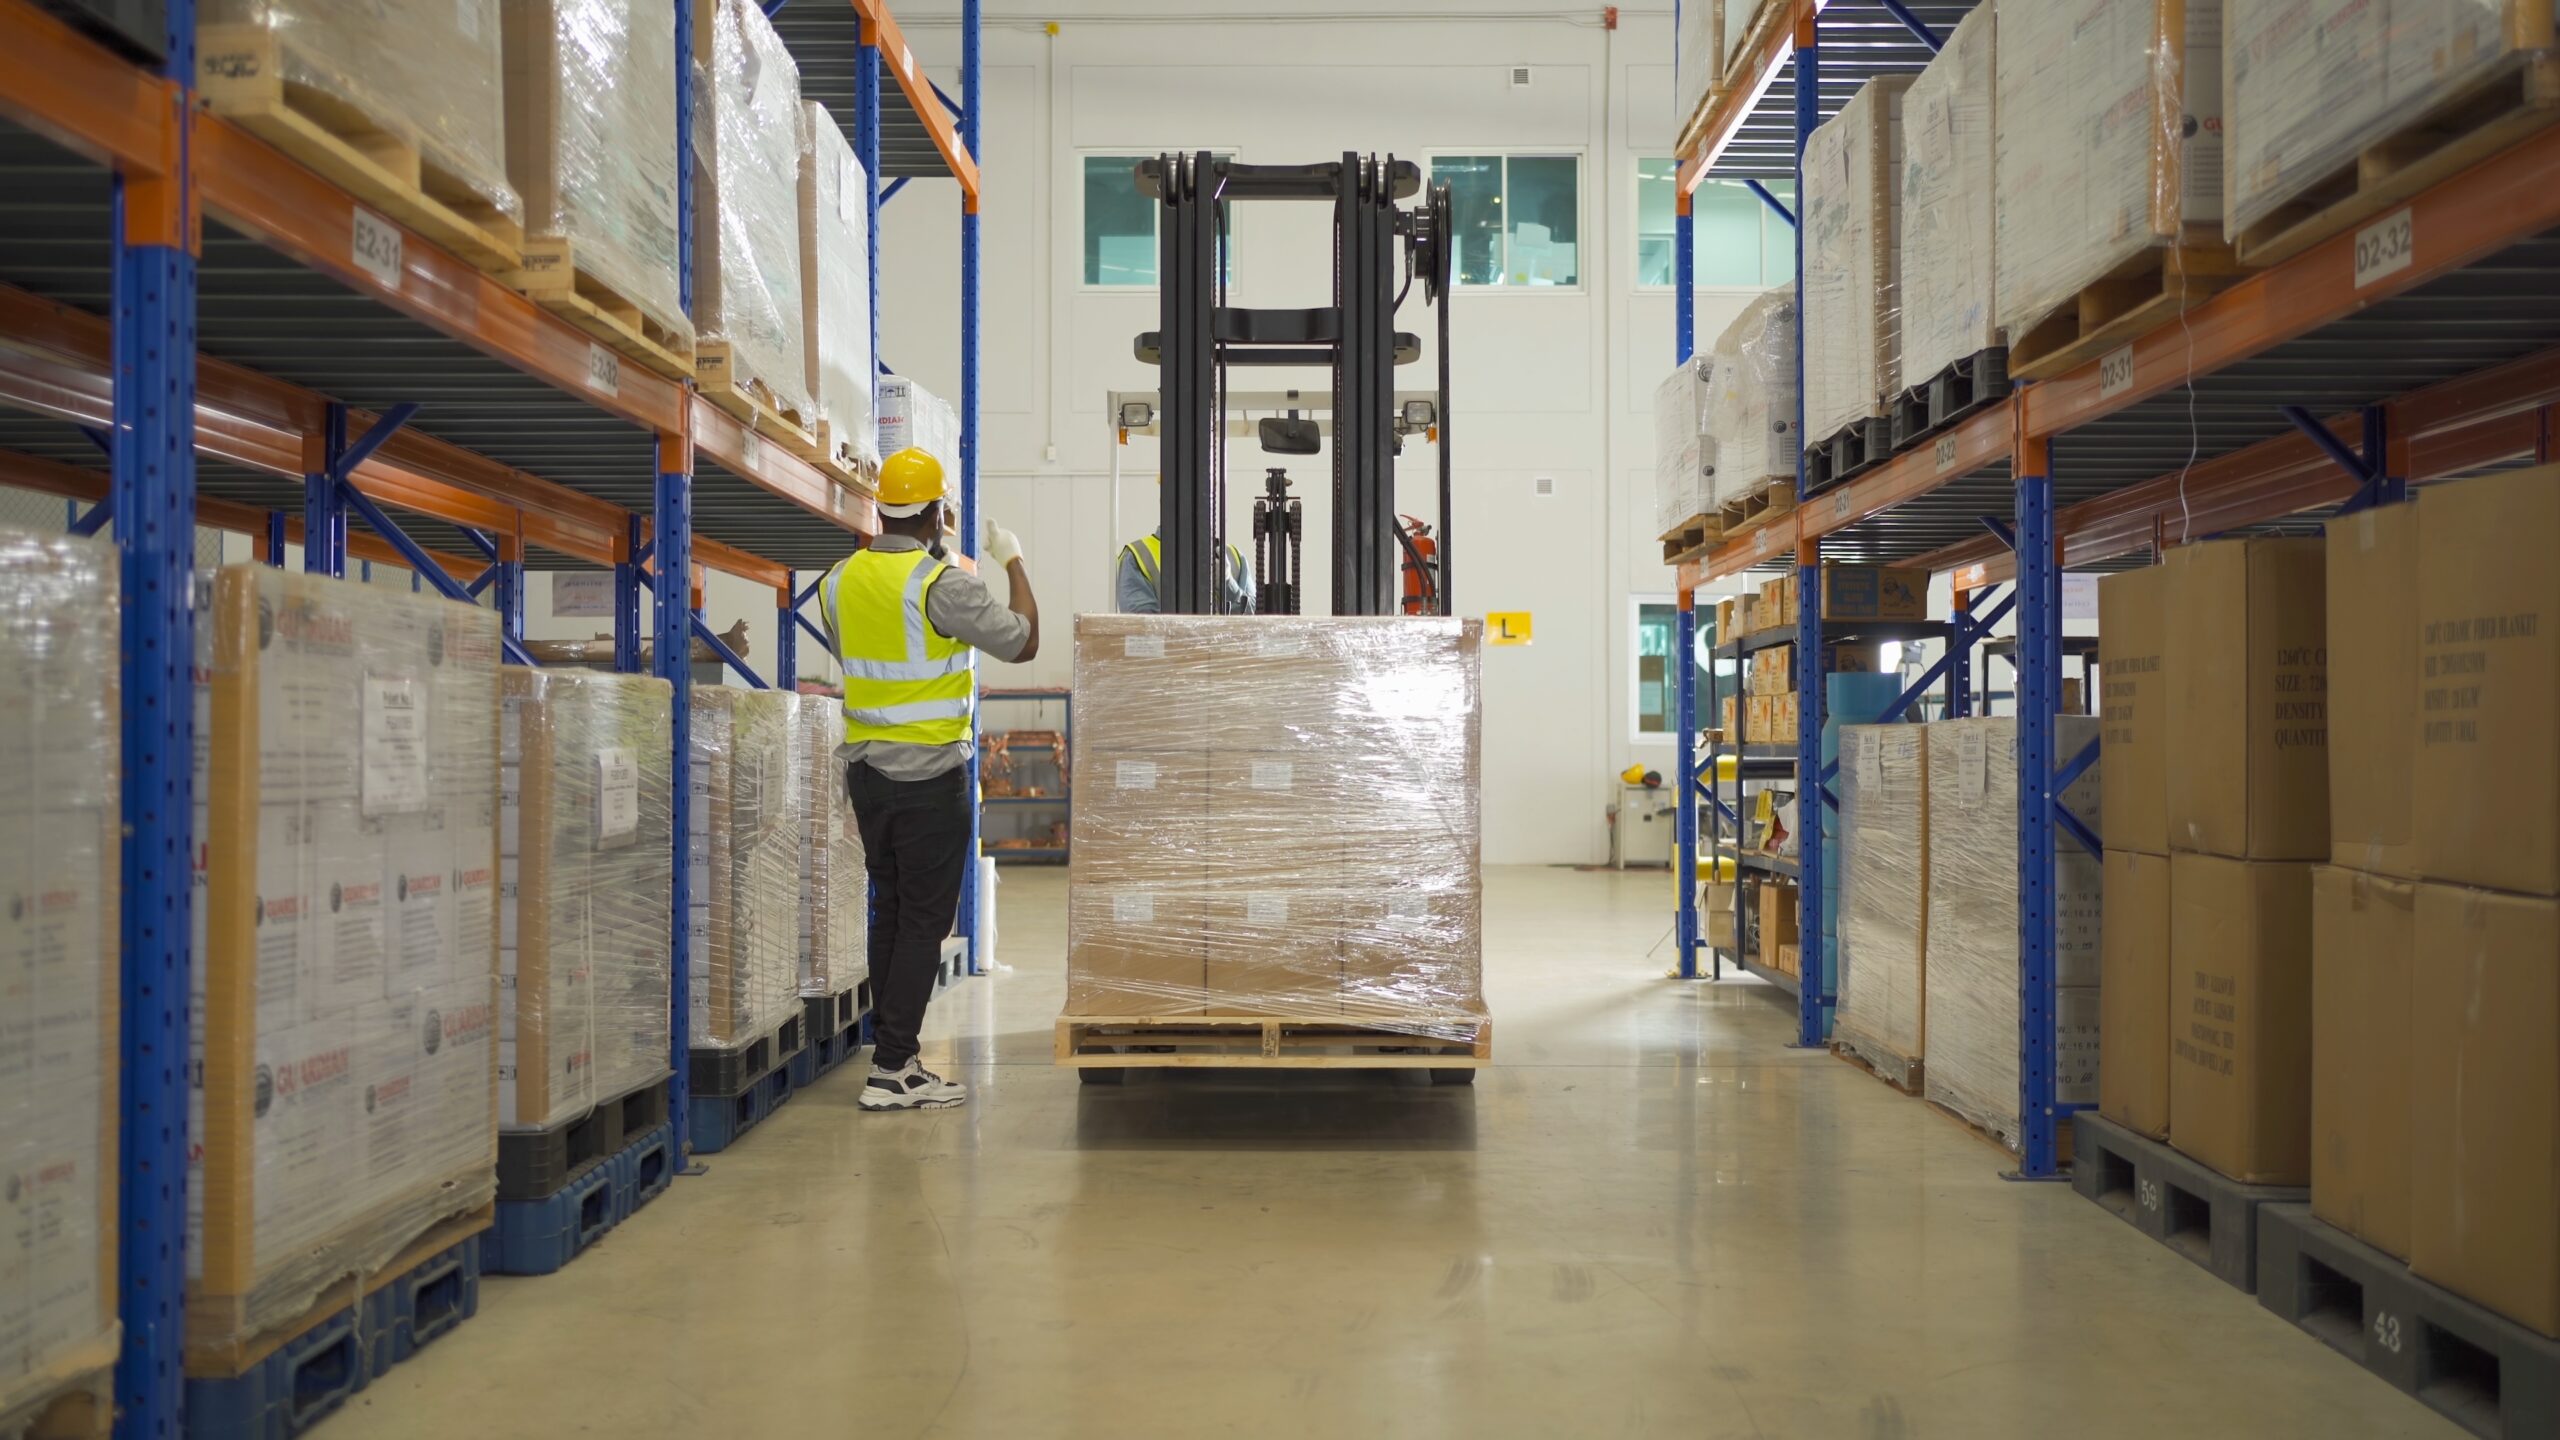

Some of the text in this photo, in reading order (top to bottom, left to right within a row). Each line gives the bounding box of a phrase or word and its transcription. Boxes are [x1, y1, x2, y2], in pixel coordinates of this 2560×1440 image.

[355, 219, 400, 273] E2-31
[2356, 220, 2411, 273] D2-32
[591, 352, 617, 388] E2-32
[2101, 353, 2132, 390] D2-31
[1936, 440, 1956, 466] D2-22
[1501, 618, 1516, 639] L
[2141, 1179, 2158, 1212] 59
[2373, 1310, 2401, 1353] 43
